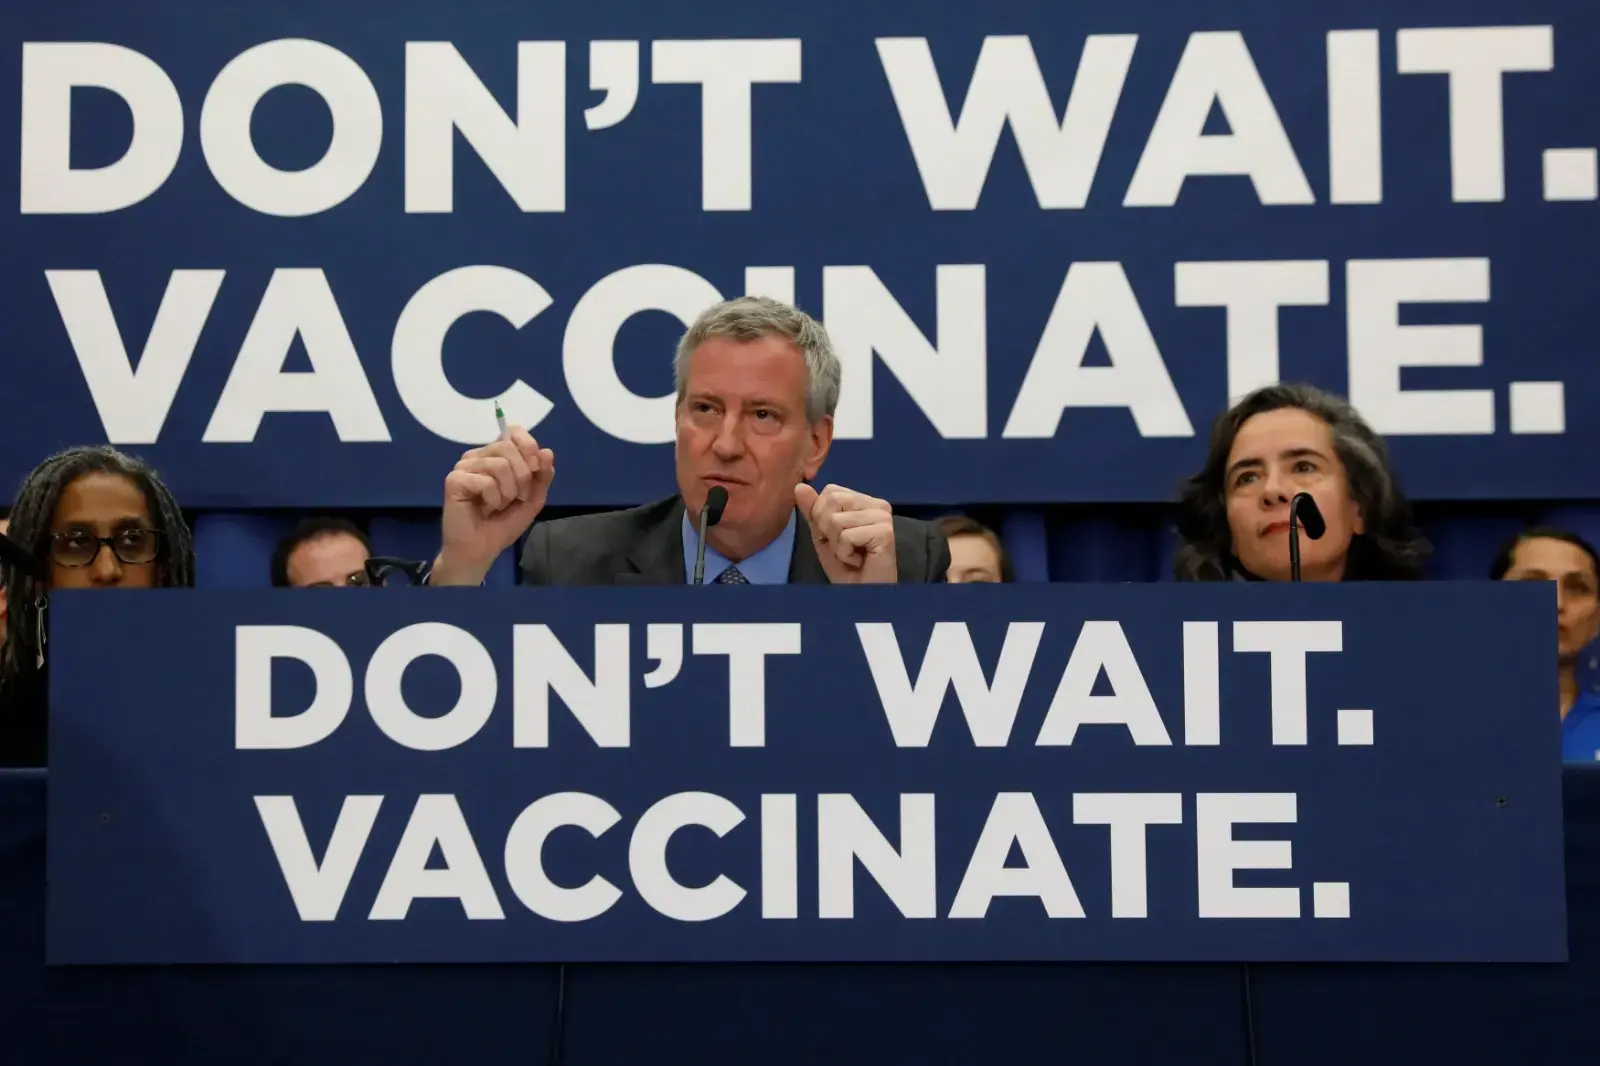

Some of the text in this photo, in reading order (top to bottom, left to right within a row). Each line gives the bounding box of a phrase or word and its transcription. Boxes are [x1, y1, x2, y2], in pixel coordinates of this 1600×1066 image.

[20, 25, 1598, 216] DON'T WAIT.
[44, 257, 1565, 446] VACCNATE.
[235, 620, 1375, 751] DON'T WAIT.
[253, 791, 1351, 923] VACCINATE.
